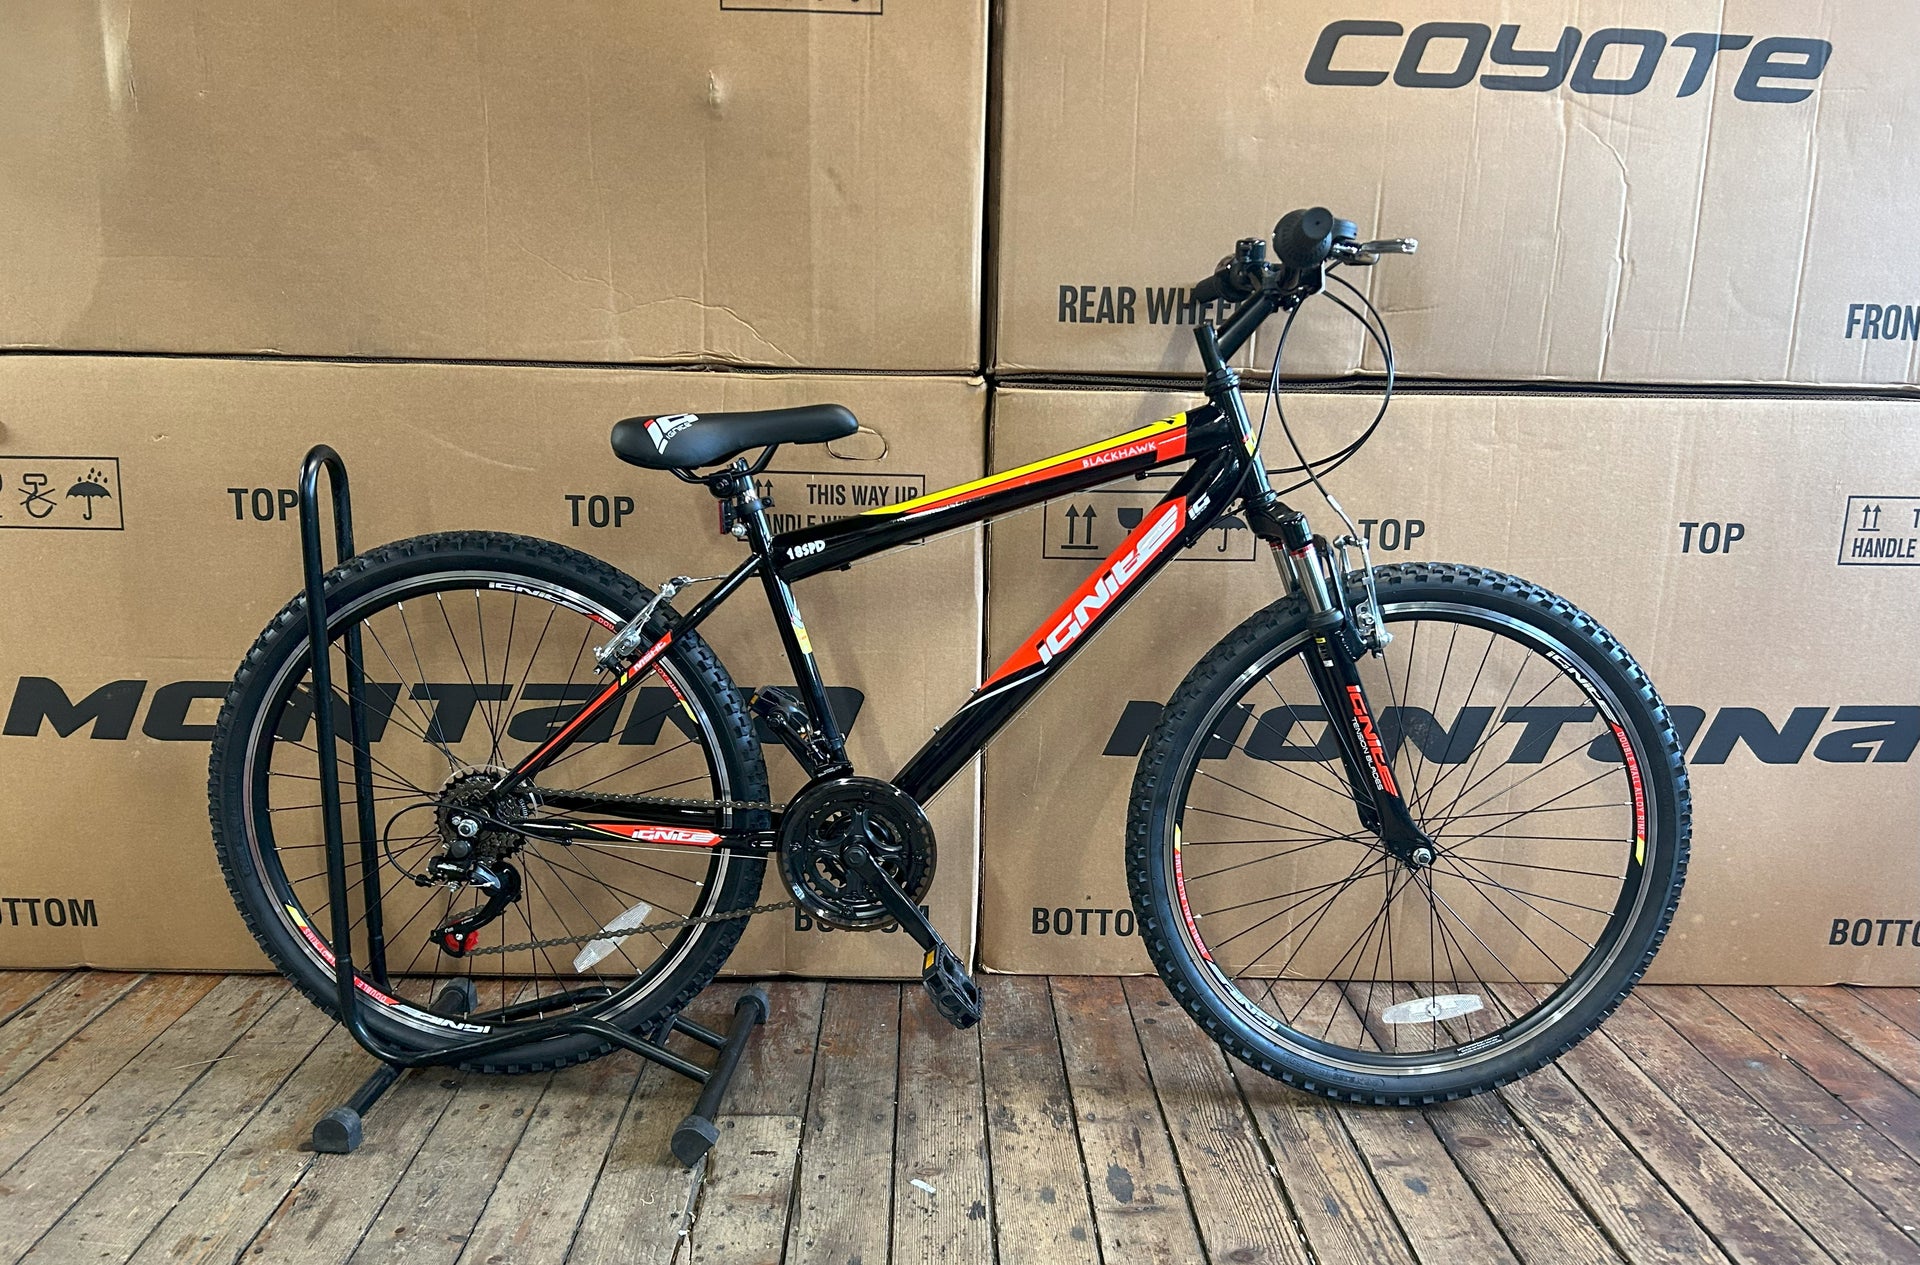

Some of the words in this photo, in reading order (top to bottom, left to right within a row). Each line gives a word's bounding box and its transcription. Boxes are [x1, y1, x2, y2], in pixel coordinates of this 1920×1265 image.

[1058, 285, 1137, 324] REAR
[1146, 287, 1243, 326] WHEE
[1082, 441, 1157, 469] BLACKHAWK
[227, 488, 299, 521] TOP
[564, 494, 635, 528] TOP
[807, 484, 846, 505] THIS
[852, 485, 890, 506] WAY
[786, 540, 826, 560] 18SPD
[1358, 518, 1426, 551] TOP
[1679, 522, 1745, 554] TOP
[1852, 537, 1918, 558] HANDLE
[1351, 716, 1370, 756] TENSION
[1365, 755, 1384, 791] BLADES
[1616, 730, 1636, 764] DOUBLE
[1628, 763, 1643, 788] WALL
[0, 897, 99, 927] TTOM
[1031, 908, 1142, 936] BOTTO
